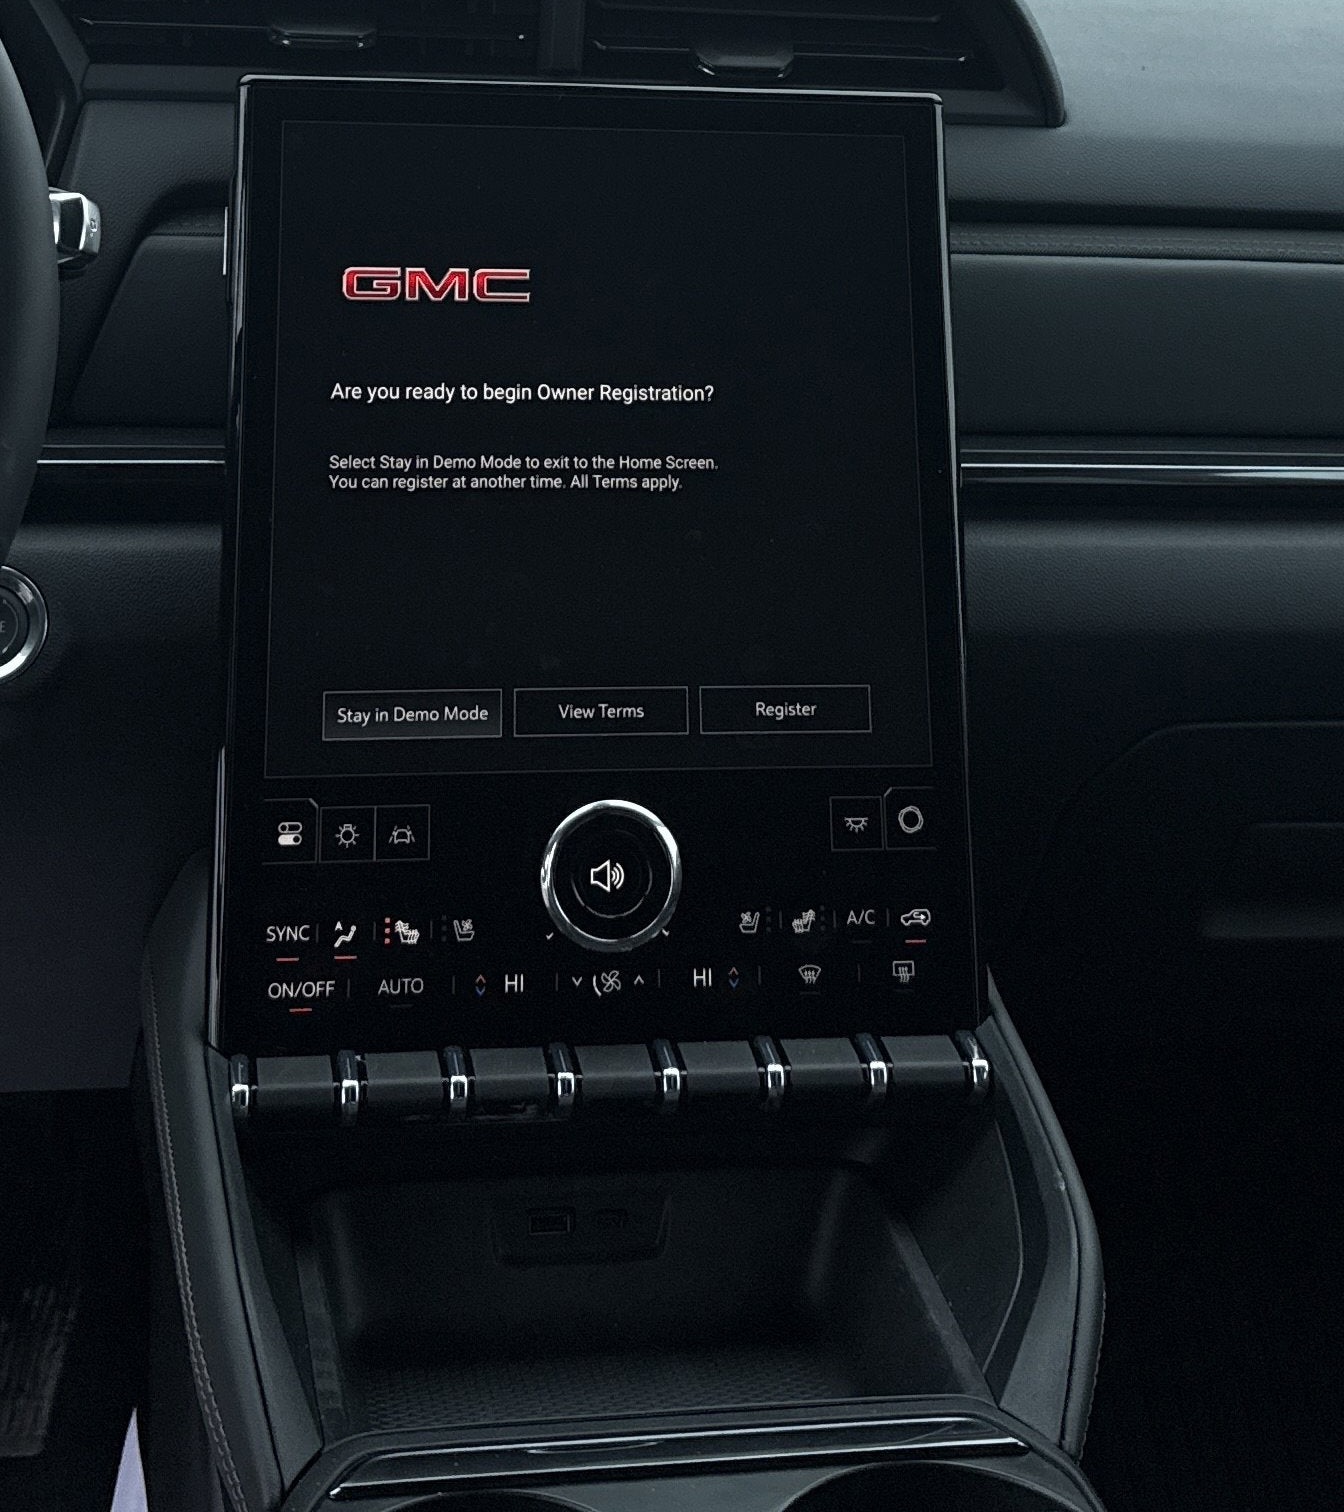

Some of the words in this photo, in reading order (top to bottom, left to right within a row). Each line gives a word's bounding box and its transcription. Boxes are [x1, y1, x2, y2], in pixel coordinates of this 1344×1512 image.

[342, 267, 530, 303] GMC
[330, 382, 363, 401] Are
[367, 386, 401, 404] you
[405, 382, 456, 405] ready
[460, 384, 479, 401] to
[483, 382, 532, 405] begin
[537, 383, 595, 402] Owner
[599, 384, 715, 405] Registration?
[329, 454, 376, 470] Select
[379, 454, 413, 473] Stay
[415, 455, 429, 470] in
[433, 455, 477, 470] Demo
[480, 455, 522, 470] Mode
[525, 455, 541, 470] to
[544, 455, 570, 470] exit
[573, 455, 589, 470] to
[592, 455, 616, 470] the
[619, 455, 663, 470] Home
[666, 455, 719, 471] Screen.
[329, 474, 358, 490] You
[362, 477, 389, 490] can
[393, 474, 449, 493] register
[452, 476, 467, 490] at
[470, 474, 527, 490] another
[530, 474, 567, 489] time.
[570, 474, 589, 489] All
[592, 474, 638, 490] Terms
[641, 474, 684, 493] apply.
[337, 707, 371, 728] Stay
[375, 707, 389, 723] in
[393, 707, 440, 723] Demo
[444, 705, 489, 722] Mode
[558, 703, 595, 720] View
[599, 703, 645, 720] Terms
[755, 701, 817, 721] Register
[846, 908, 875, 925] A/C
[266, 925, 311, 943] SYNC
[377, 977, 425, 996] AUTO
[504, 973, 525, 993] HI
[693, 967, 713, 988] HI
[267, 980, 336, 999] ON/OFF
